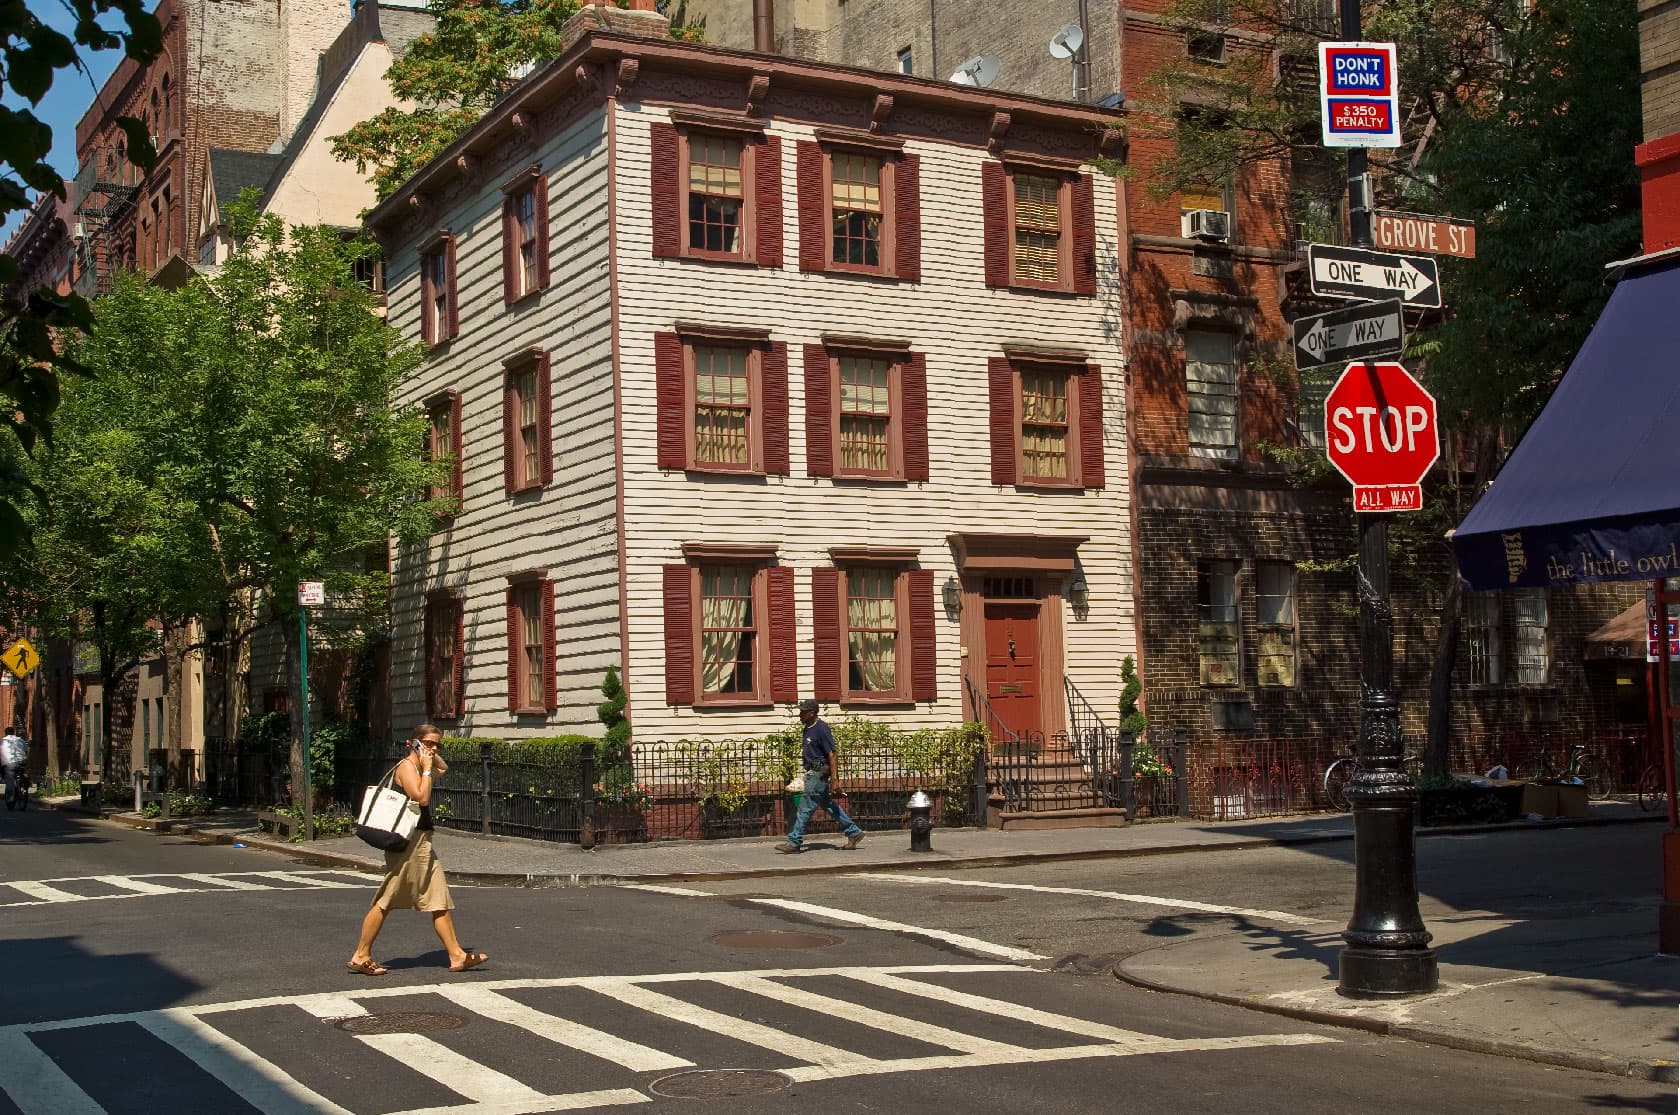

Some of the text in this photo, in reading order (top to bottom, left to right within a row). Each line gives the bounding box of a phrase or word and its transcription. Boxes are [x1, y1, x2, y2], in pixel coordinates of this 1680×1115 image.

[1335, 57, 1381, 71] DON'T
[1337, 72, 1380, 87] HONK
[1335, 116, 1385, 128] PENALTY
[1343, 105, 1377, 117] $350
[1380, 217, 1467, 254] GROVE ST
[1328, 261, 1419, 290] ONE WAY
[1307, 318, 1385, 352] ONE WAY
[1332, 405, 1429, 454] STOP
[1360, 490, 1415, 507] ALL WAY
[1547, 542, 1680, 580] the little owl
